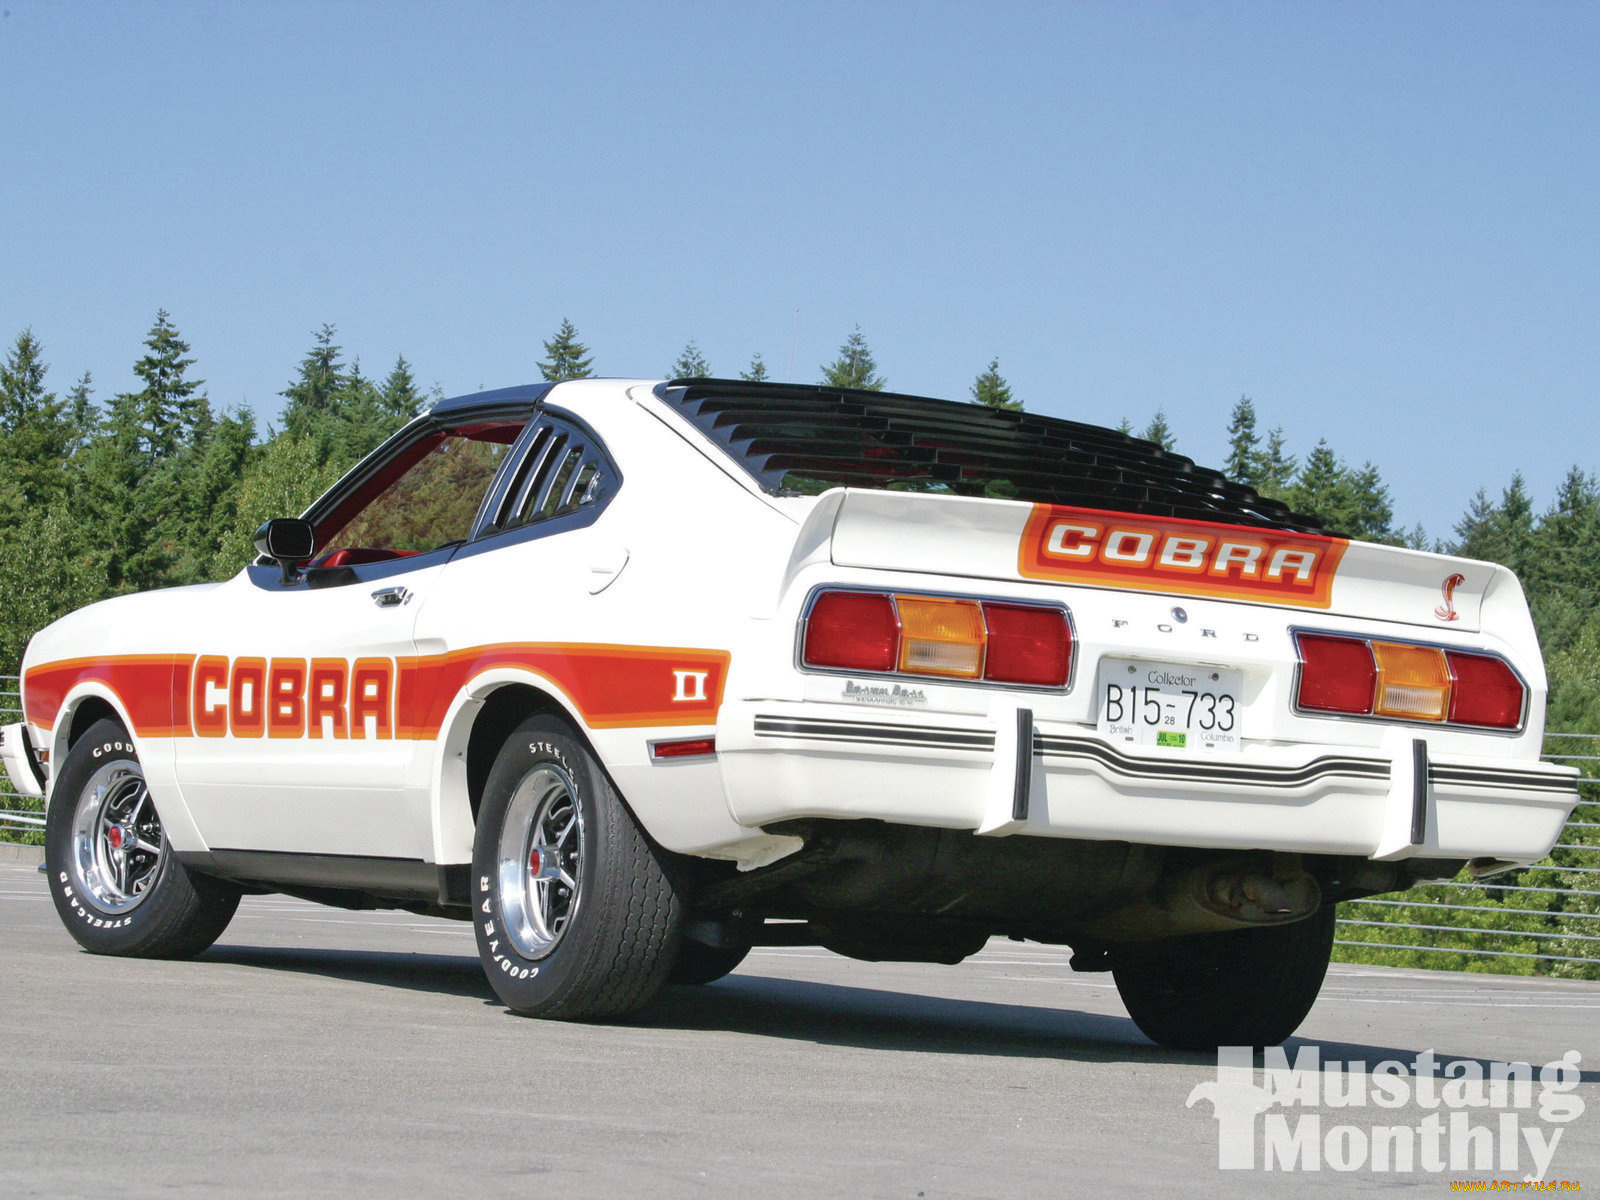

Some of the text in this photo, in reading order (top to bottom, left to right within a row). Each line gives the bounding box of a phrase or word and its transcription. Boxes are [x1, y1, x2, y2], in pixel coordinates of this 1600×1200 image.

[1047, 523, 1317, 581] COBRA
[1112, 618, 1260, 643] FORD
[672, 670, 709, 702] II
[1147, 670, 1196, 687] Collector
[194, 654, 395, 740] COBRA
[1106, 683, 1235, 732] B15-733
[1109, 724, 1234, 743] British Columbia
[1164, 715, 1176, 726] 28
[1156, 732, 1168, 743] JUL
[1178, 734, 1186, 744] 10
[60, 871, 132, 929] STEELGARD
